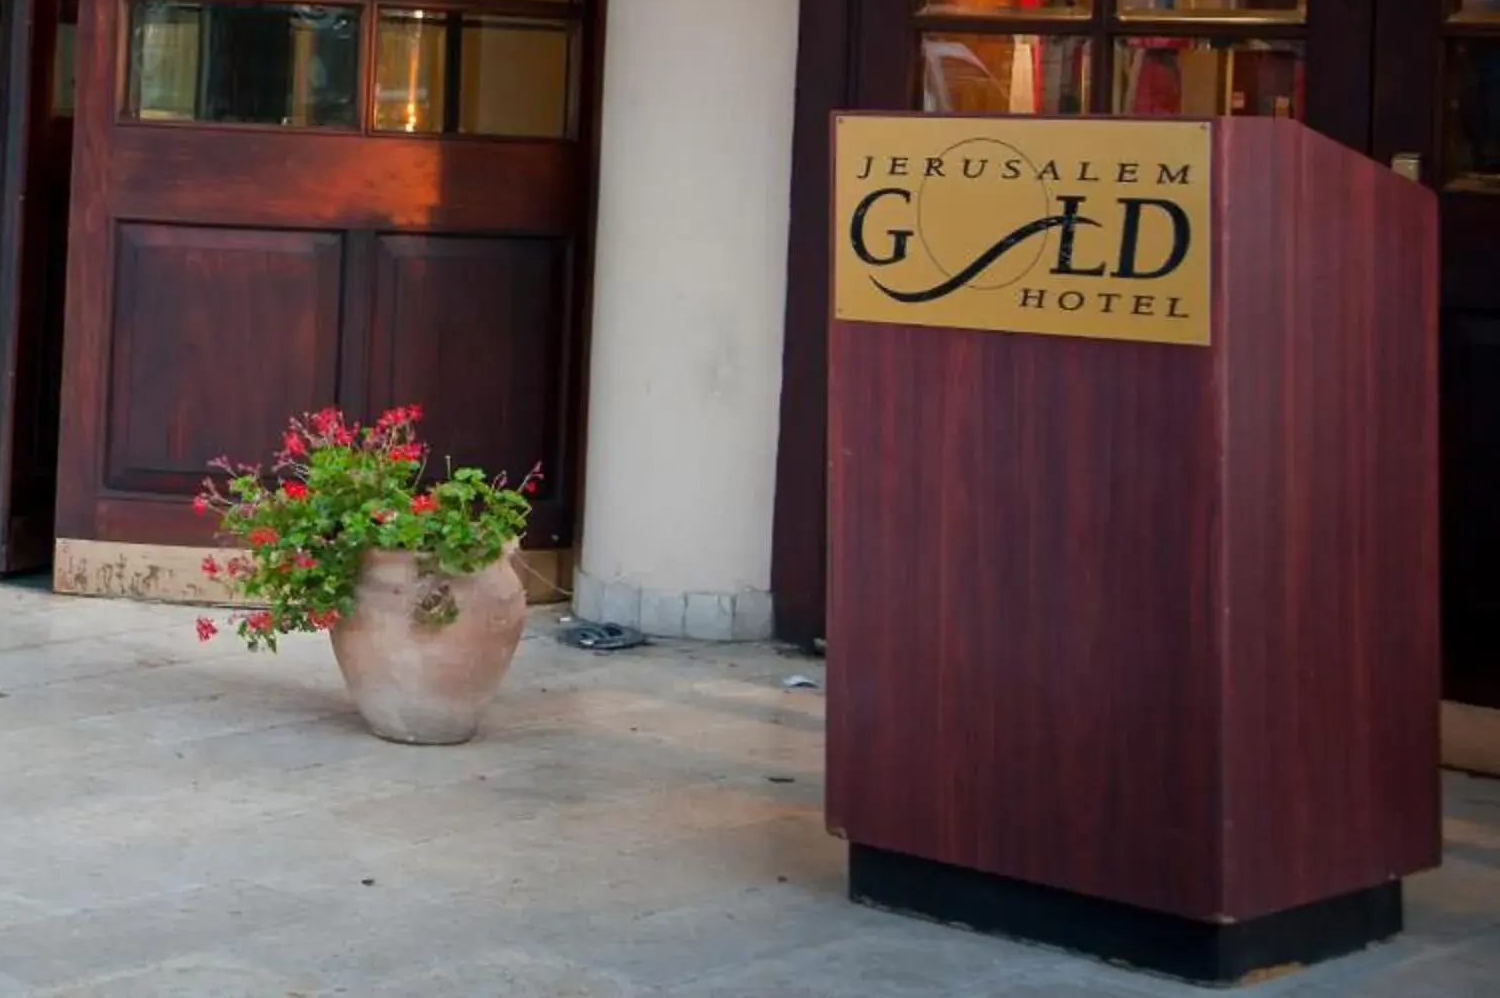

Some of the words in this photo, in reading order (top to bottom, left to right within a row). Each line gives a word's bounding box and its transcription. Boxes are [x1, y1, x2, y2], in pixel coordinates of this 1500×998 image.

[856, 155, 1192, 186] JERUSALEM
[849, 186, 1192, 291] GOLD
[1018, 288, 1190, 319] HOTEL
